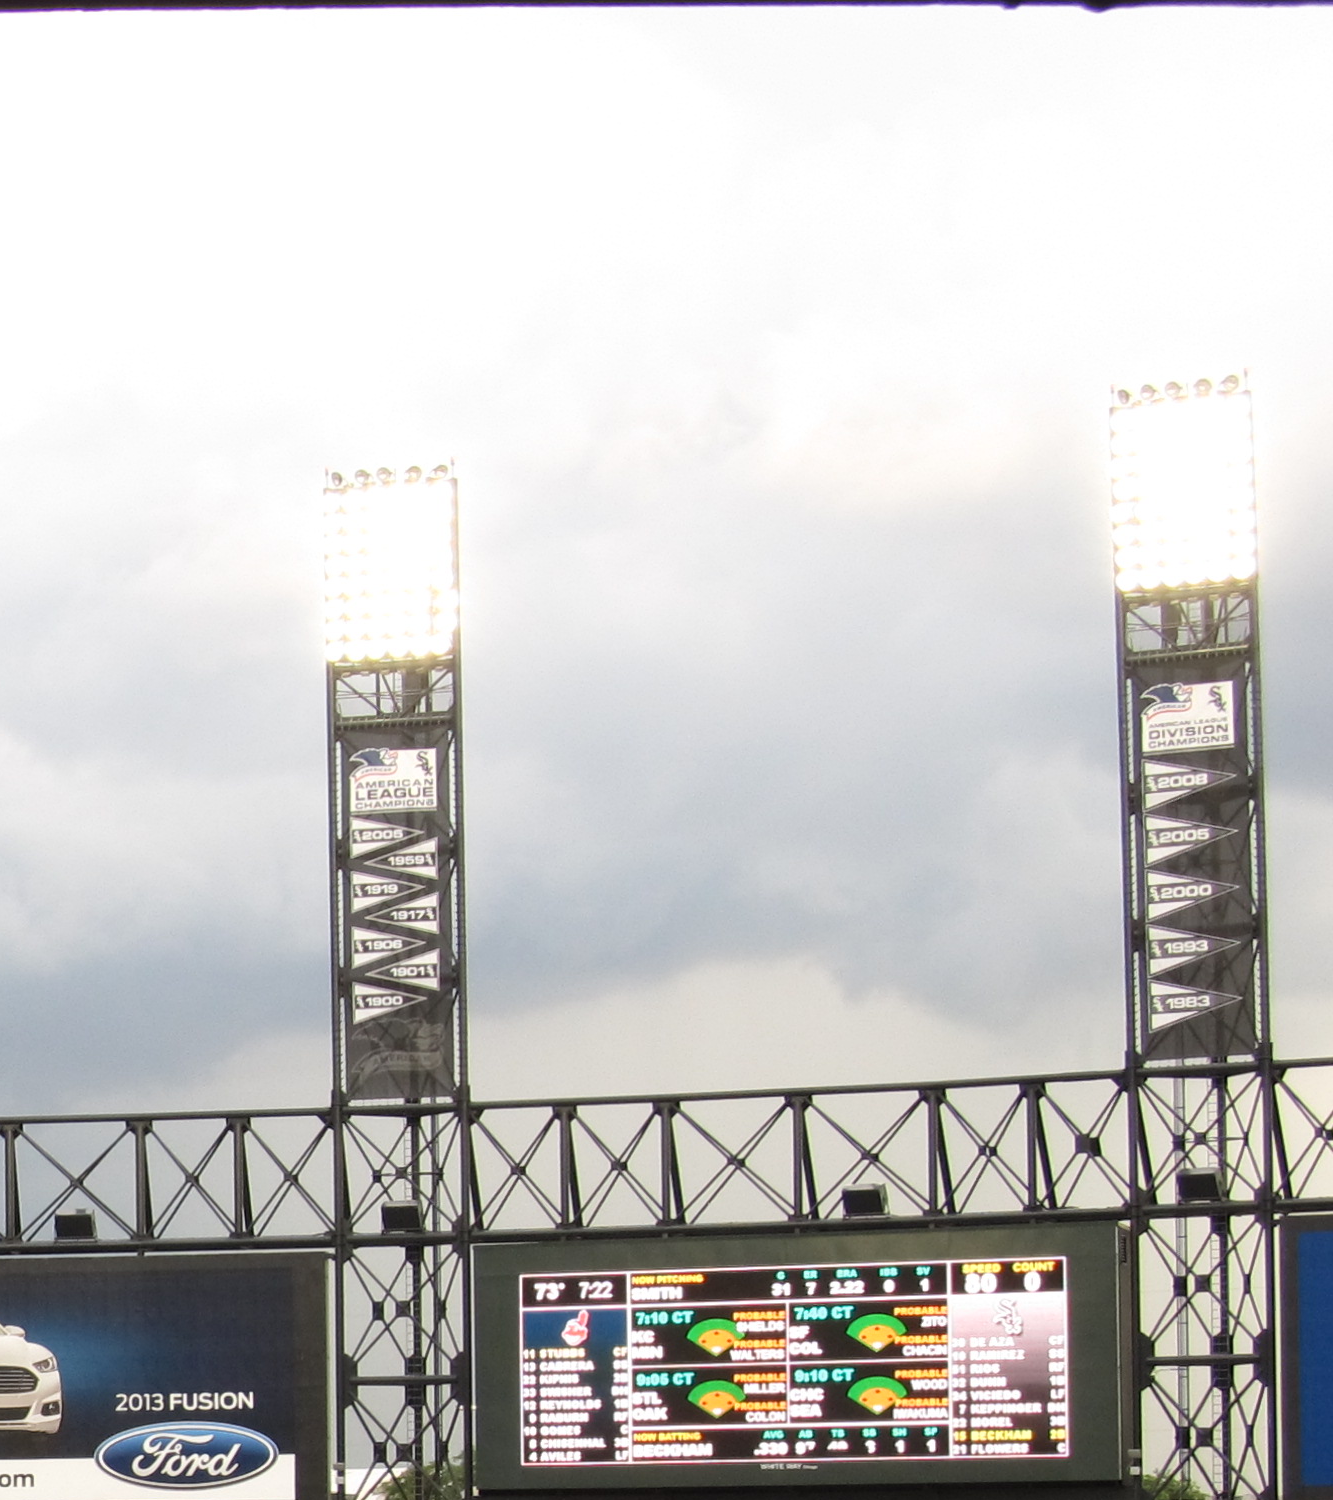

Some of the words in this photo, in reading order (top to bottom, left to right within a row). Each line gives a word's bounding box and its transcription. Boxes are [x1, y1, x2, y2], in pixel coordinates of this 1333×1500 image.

[1148, 723, 1229, 740] DIVISION
[1148, 734, 1230, 749] CHAMPIONS
[355, 778, 434, 790] AMERICAN
[1157, 772, 1208, 789] 2008
[355, 786, 434, 801] LEAGUE
[355, 798, 435, 810] CHAMPIONS
[362, 829, 404, 841] 2005
[1159, 827, 1210, 842] 2005
[387, 855, 425, 866] 1959
[364, 883, 399, 895] 1919
[1160, 883, 1212, 899] 2000
[390, 910, 426, 920] 1917
[365, 939, 403, 950] 1906
[1164, 940, 1209, 954] 1993
[390, 967, 426, 977] 1901
[366, 995, 403, 1006] 1900
[1165, 995, 1211, 1009] 1983
[962, 1264, 1002, 1274] SPEED
[1012, 1261, 1056, 1272] COUNT
[672, 1310, 694, 1324] CT
[831, 1305, 854, 1319] CT
[672, 1372, 695, 1385] CT
[832, 1368, 855, 1381] CT
[116, 1394, 165, 1412] 2013
[168, 1391, 255, 1411] FUSION
[970, 1429, 1033, 1441] BECKHAM
[131, 1434, 242, 1478] Ford
